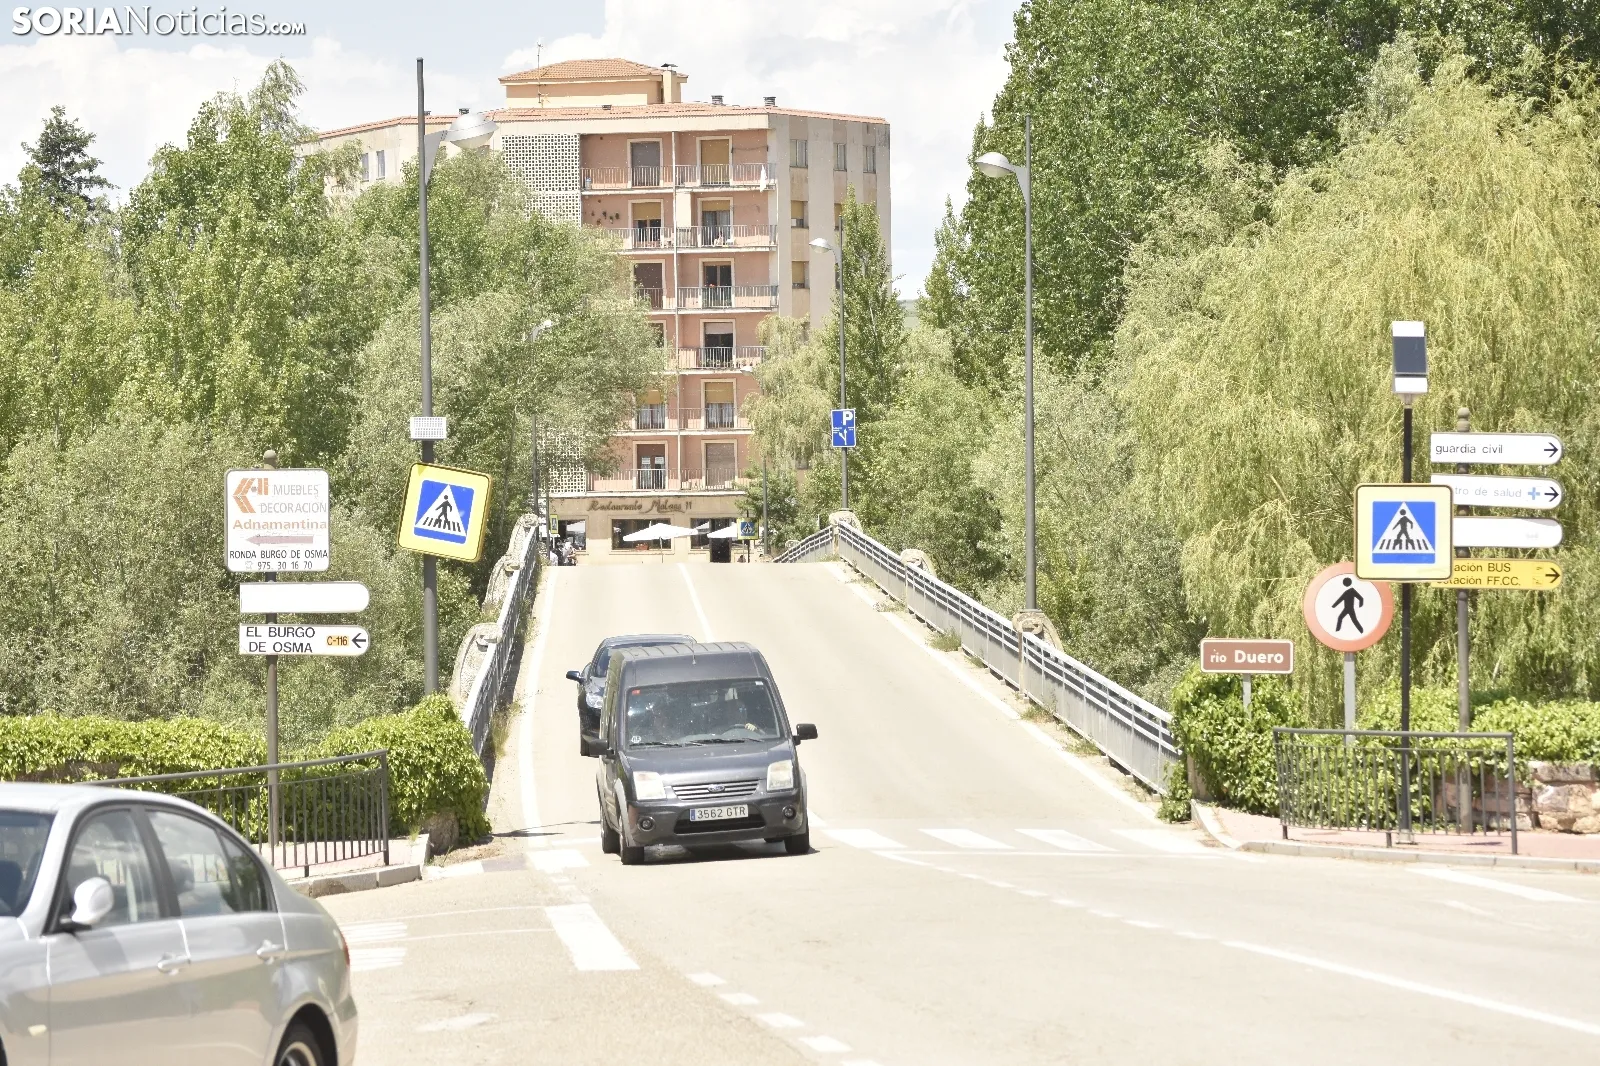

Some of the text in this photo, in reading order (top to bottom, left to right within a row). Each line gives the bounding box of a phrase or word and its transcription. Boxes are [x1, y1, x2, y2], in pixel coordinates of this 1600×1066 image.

[1435, 443, 1503, 455] guardia civil
[273, 484, 319, 496] MUEBLES
[1474, 486, 1488, 496] de
[1494, 488, 1522, 498] salud
[232, 519, 327, 530] Adnamantina
[229, 549, 328, 559] RONDA BURGO DE OSMA
[278, 561, 287, 570] 30
[291, 561, 299, 570] 16
[304, 561, 313, 570] 70
[1488, 562, 1511, 572] BUS
[246, 626, 316, 638] EL BURGO
[326, 635, 348, 646] C-116
[248, 641, 313, 654] DE OSMA
[1234, 649, 1285, 664] Duero
[697, 806, 746, 819] 3562 GTR
